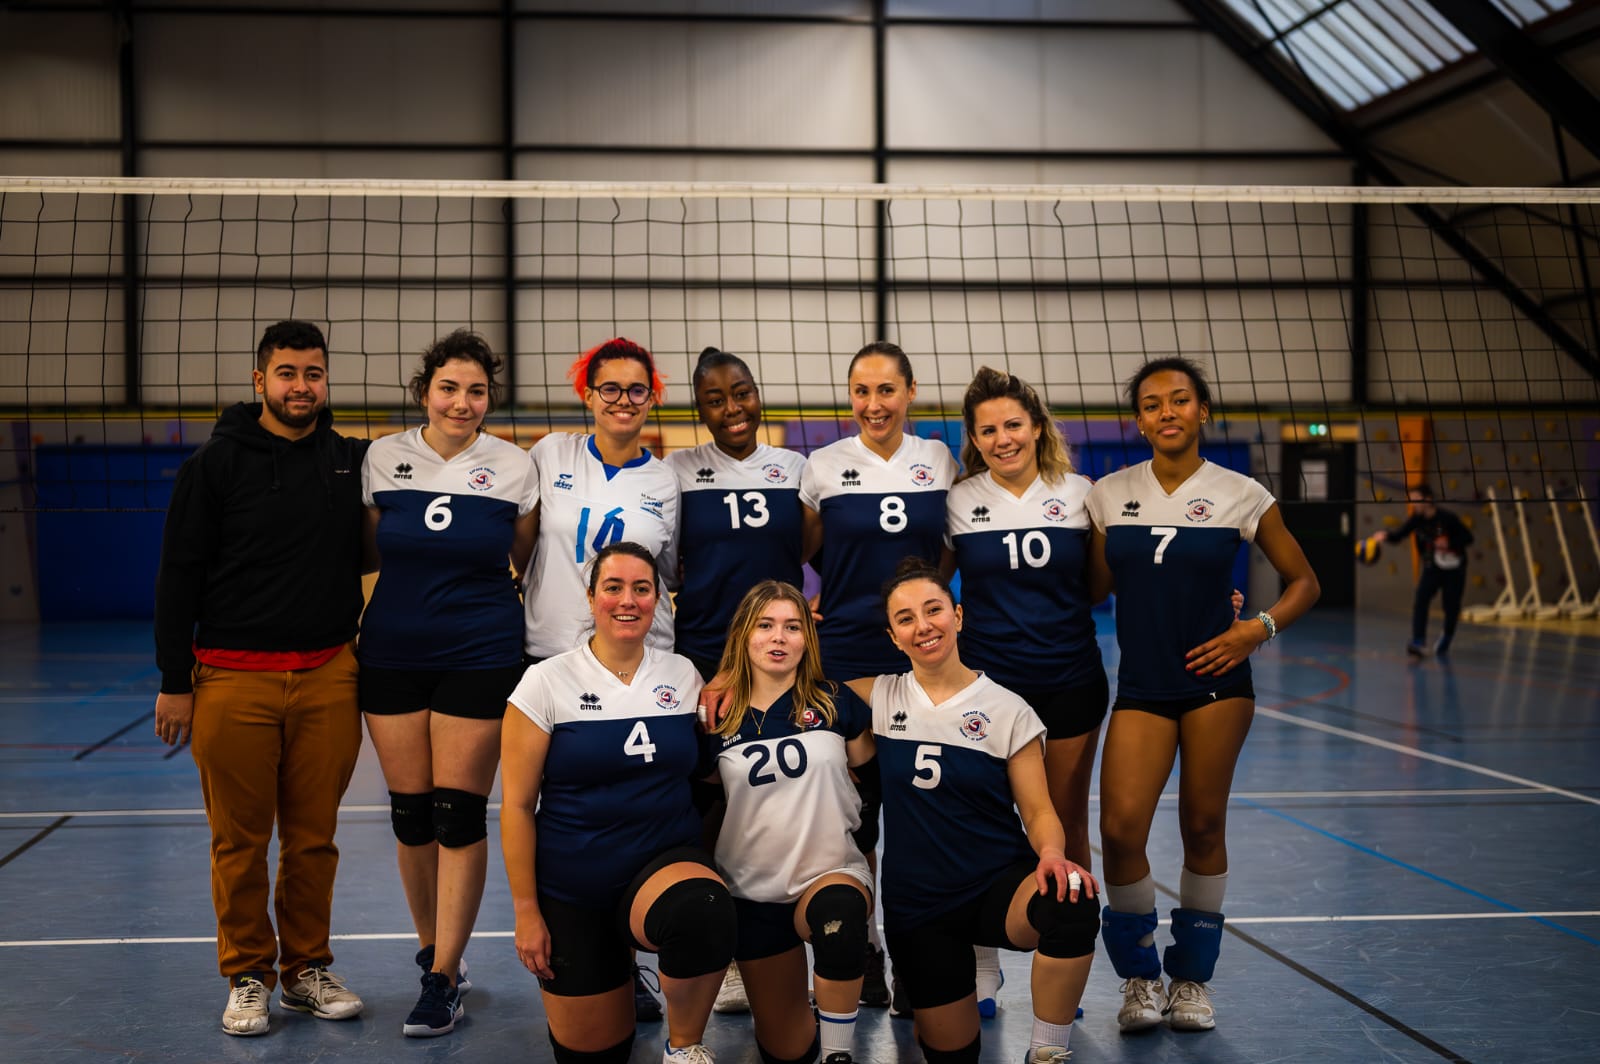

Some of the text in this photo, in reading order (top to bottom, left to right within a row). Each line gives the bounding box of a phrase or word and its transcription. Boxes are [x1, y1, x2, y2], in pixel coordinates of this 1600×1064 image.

[424, 495, 452, 531] 6
[723, 491, 770, 529] 13
[879, 496, 908, 533] 8
[1002, 530, 1051, 570] 10
[1150, 527, 1177, 564] 7
[624, 721, 656, 763] 4
[742, 738, 808, 787] 20
[912, 744, 942, 789] 5
